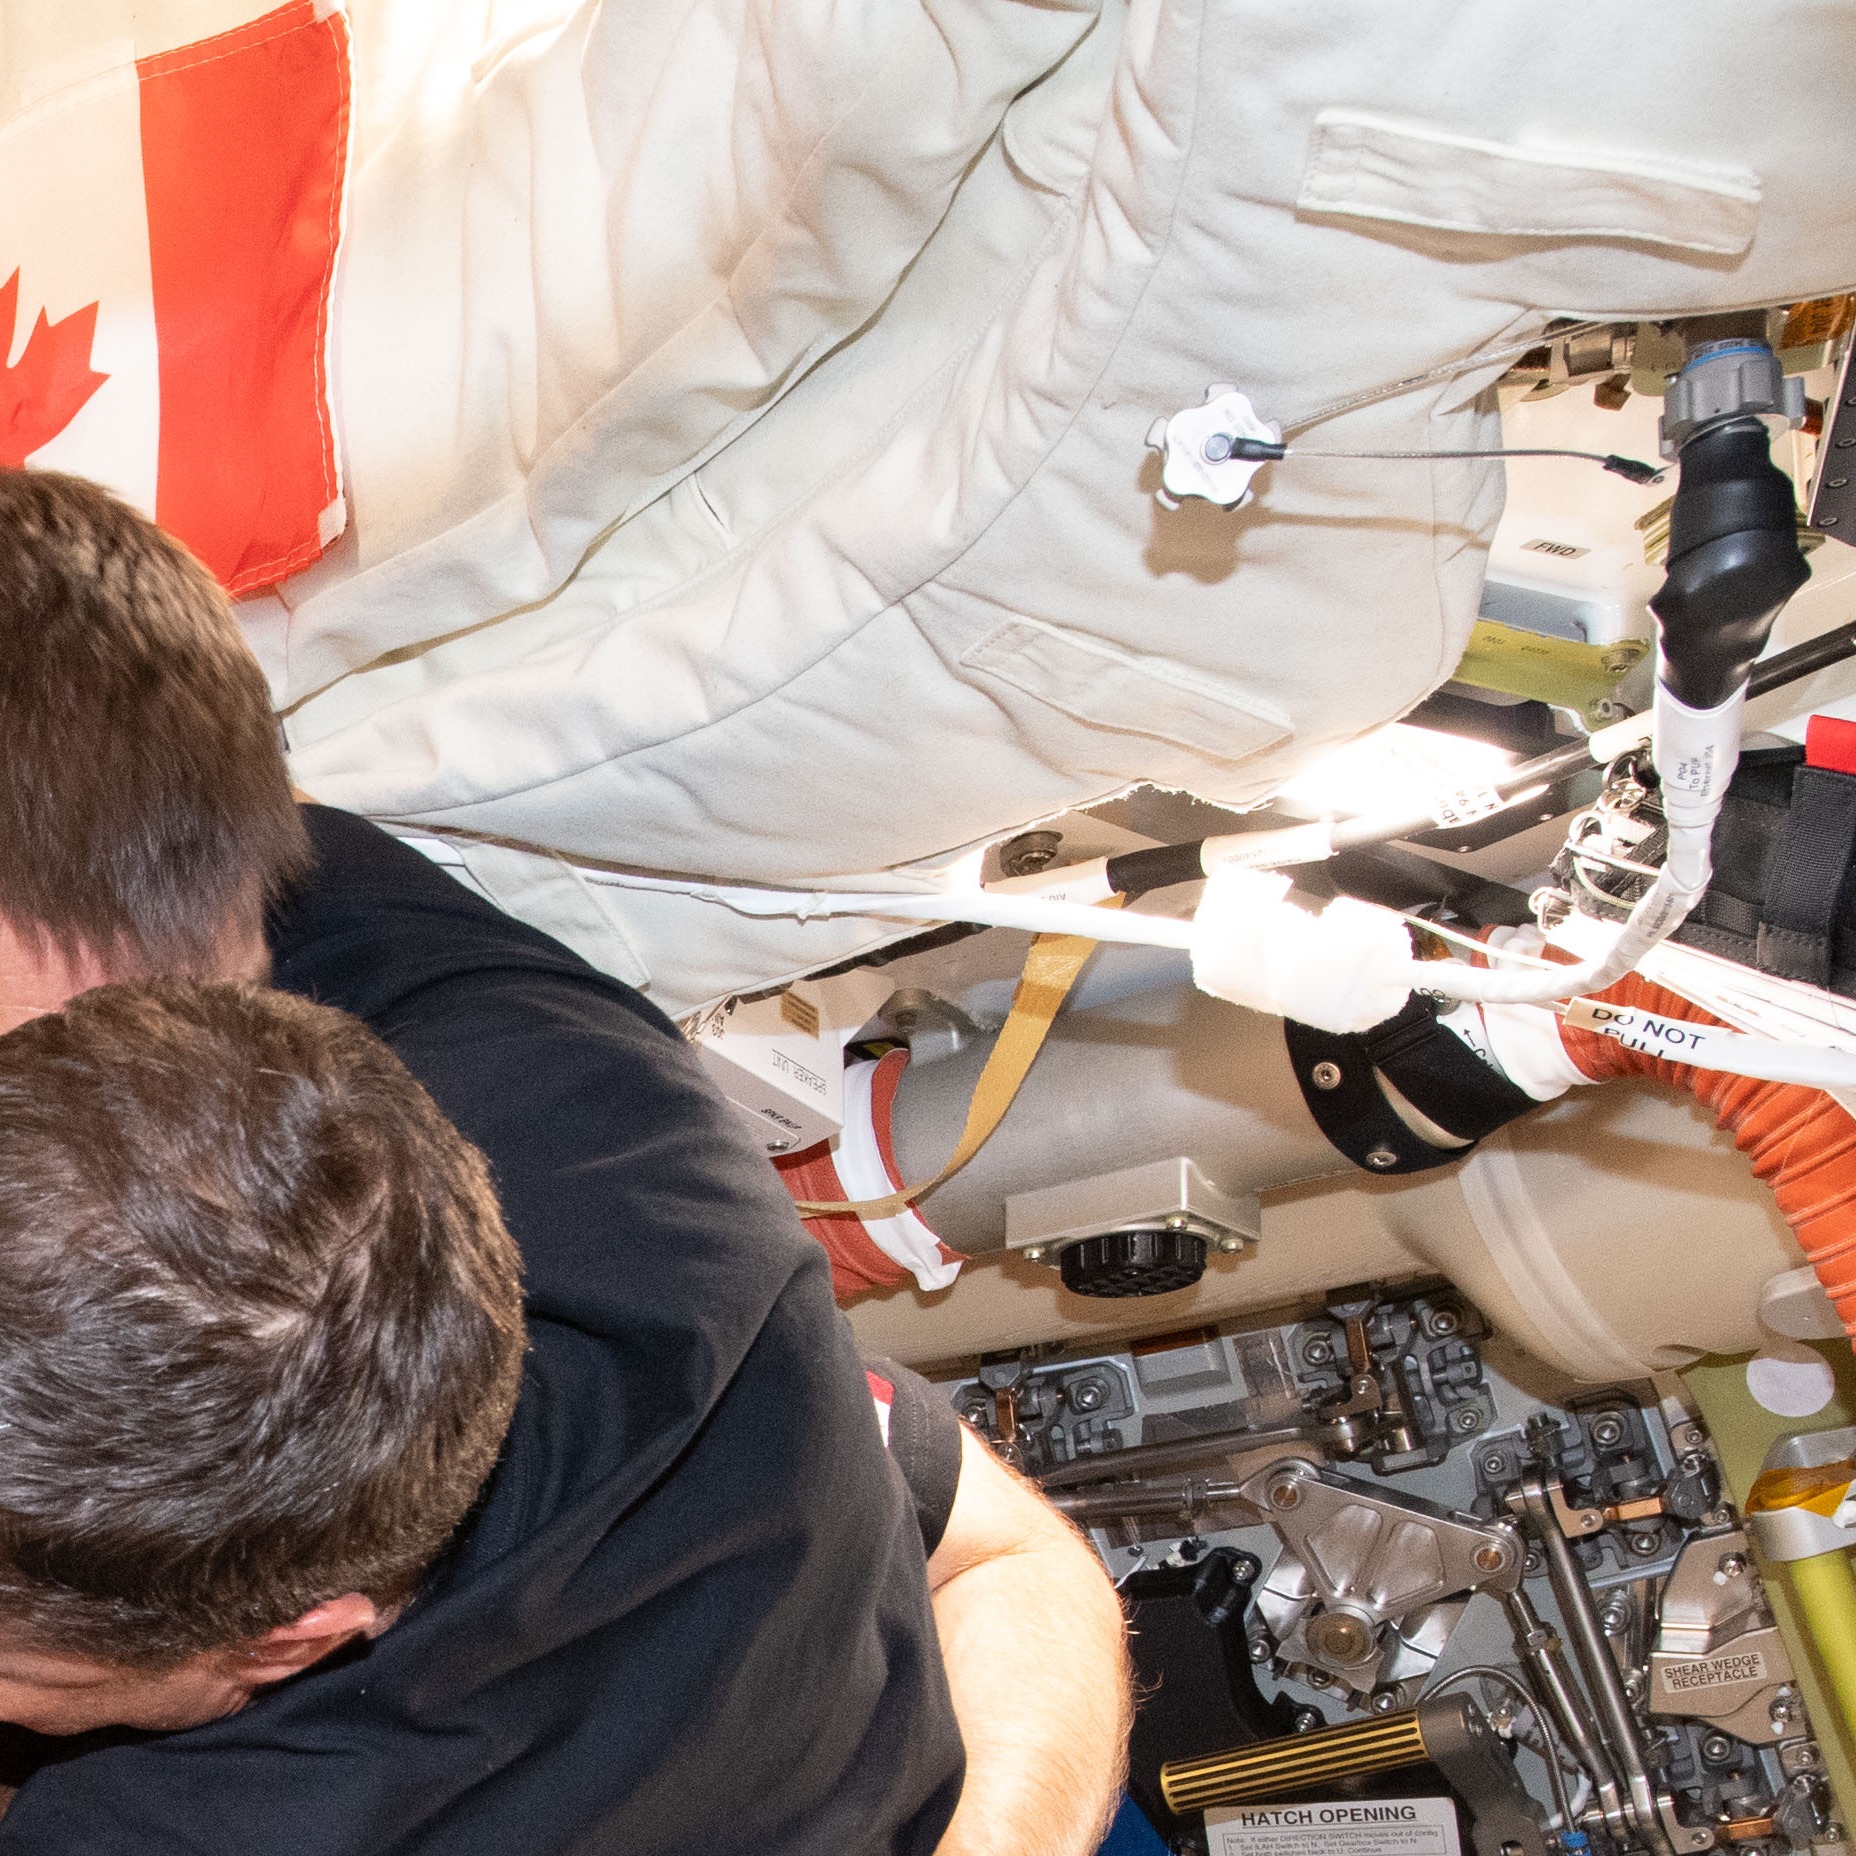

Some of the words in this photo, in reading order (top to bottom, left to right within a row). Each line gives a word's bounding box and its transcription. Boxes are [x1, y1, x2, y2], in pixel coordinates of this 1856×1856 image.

[1534, 542, 1576, 557] FWD
[1592, 1008, 1634, 1026] DO
[1643, 1020, 1706, 1049] NOT
[1664, 1662, 1709, 1679] SHEAR
[1711, 1654, 1760, 1670] WEDGE
[1672, 1666, 1758, 1690] RECEPTACLE
[1241, 1810, 1313, 1826] HATCH
[1319, 1805, 1416, 1824] OPENING
[1280, 1833, 1327, 1842] DIRECTION
[1328, 1832, 1362, 1840] SWITCH
